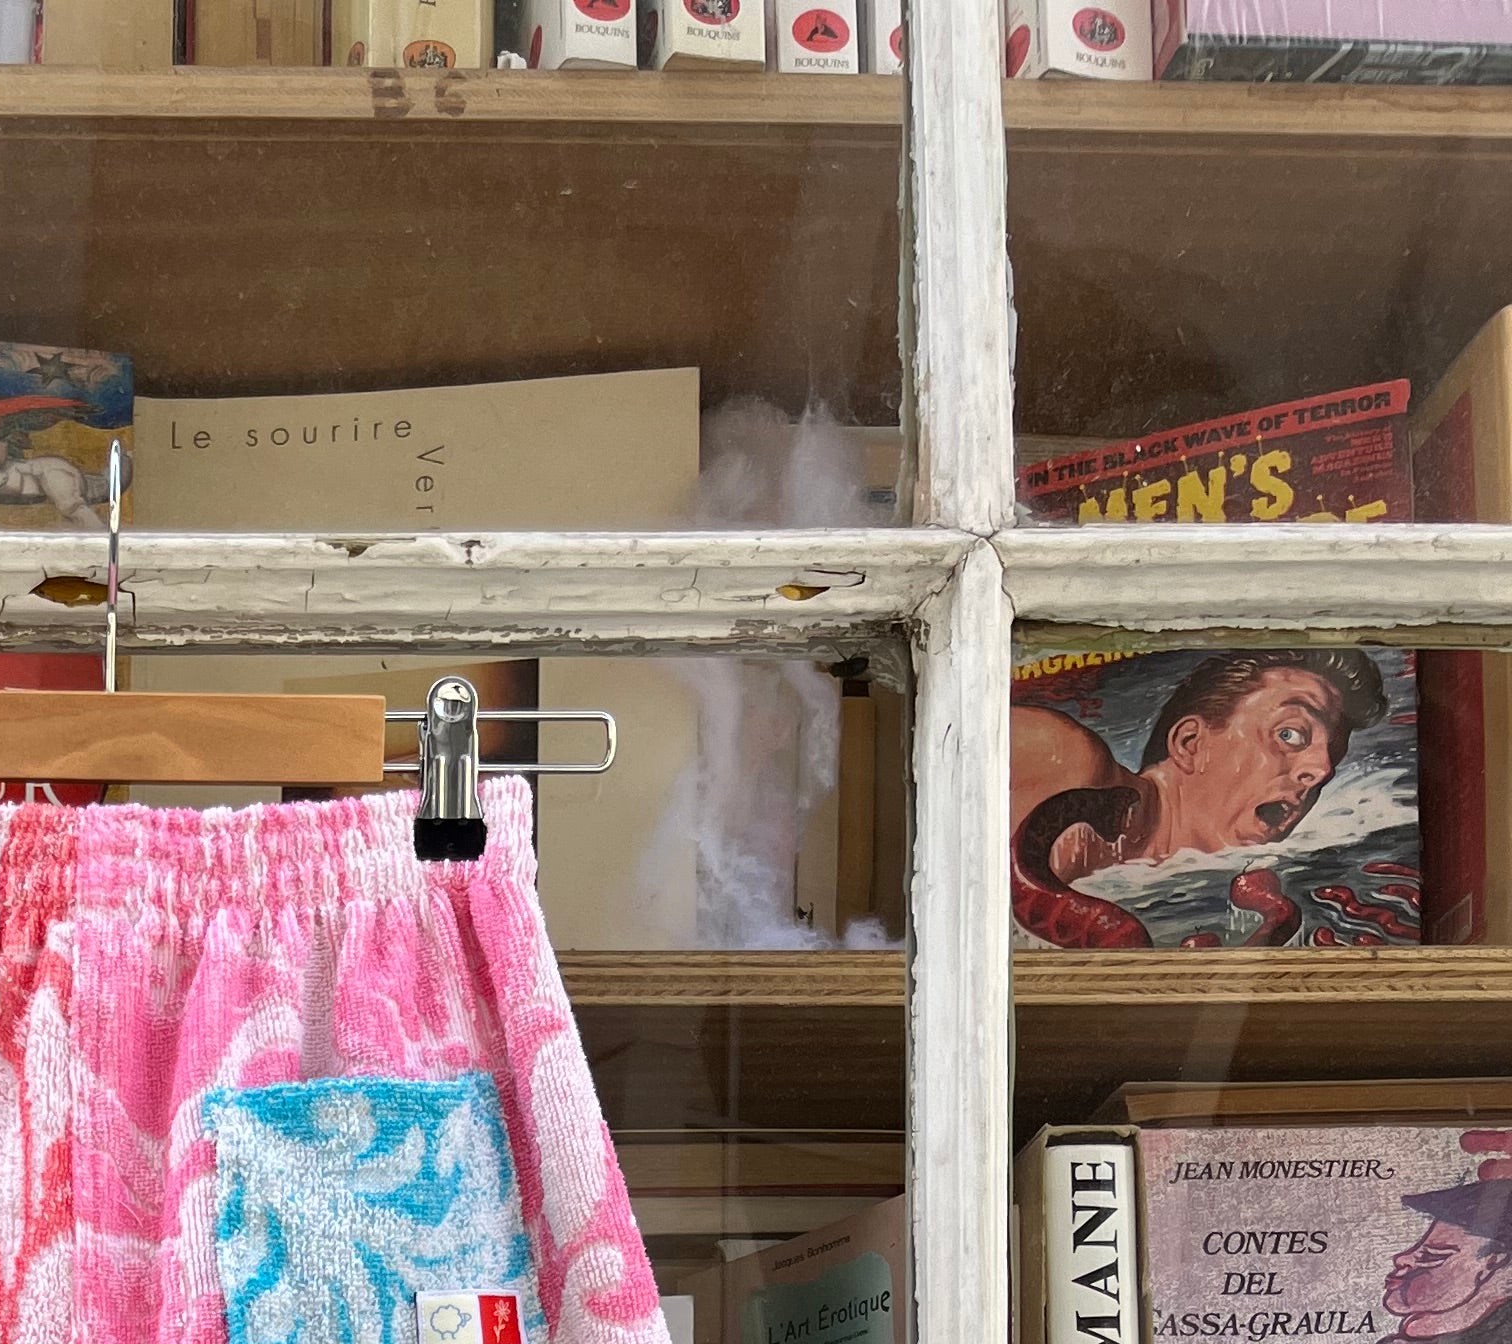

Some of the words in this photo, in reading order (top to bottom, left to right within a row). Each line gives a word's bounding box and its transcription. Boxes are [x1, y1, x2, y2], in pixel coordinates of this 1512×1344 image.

[575, 23, 630, 39] BOUQUINS
[686, 26, 740, 42] BOUQUINS
[794, 58, 850, 70] BOUQUINS
[1075, 52, 1126, 69] BOUQUINS
[171, 420, 212, 451] Le
[245, 418, 413, 448] sourire
[1026, 469, 1049, 489] IN
[1053, 457, 1097, 482] THE
[1102, 437, 1179, 471] BLACK
[1182, 420, 1252, 449] WAVE
[1256, 406, 1287, 432] OF
[1292, 391, 1391, 425] TERROR
[1170, 1161, 1236, 1184] JEAN
[1240, 1159, 1395, 1181] MONESTIER
[771, 1252, 805, 1272] Jacques
[807, 1235, 851, 1262] Bonhomme
[1202, 1230, 1329, 1256] CONTES
[1221, 1272, 1284, 1296] DEL
[819, 1290, 891, 1331] Érotique
